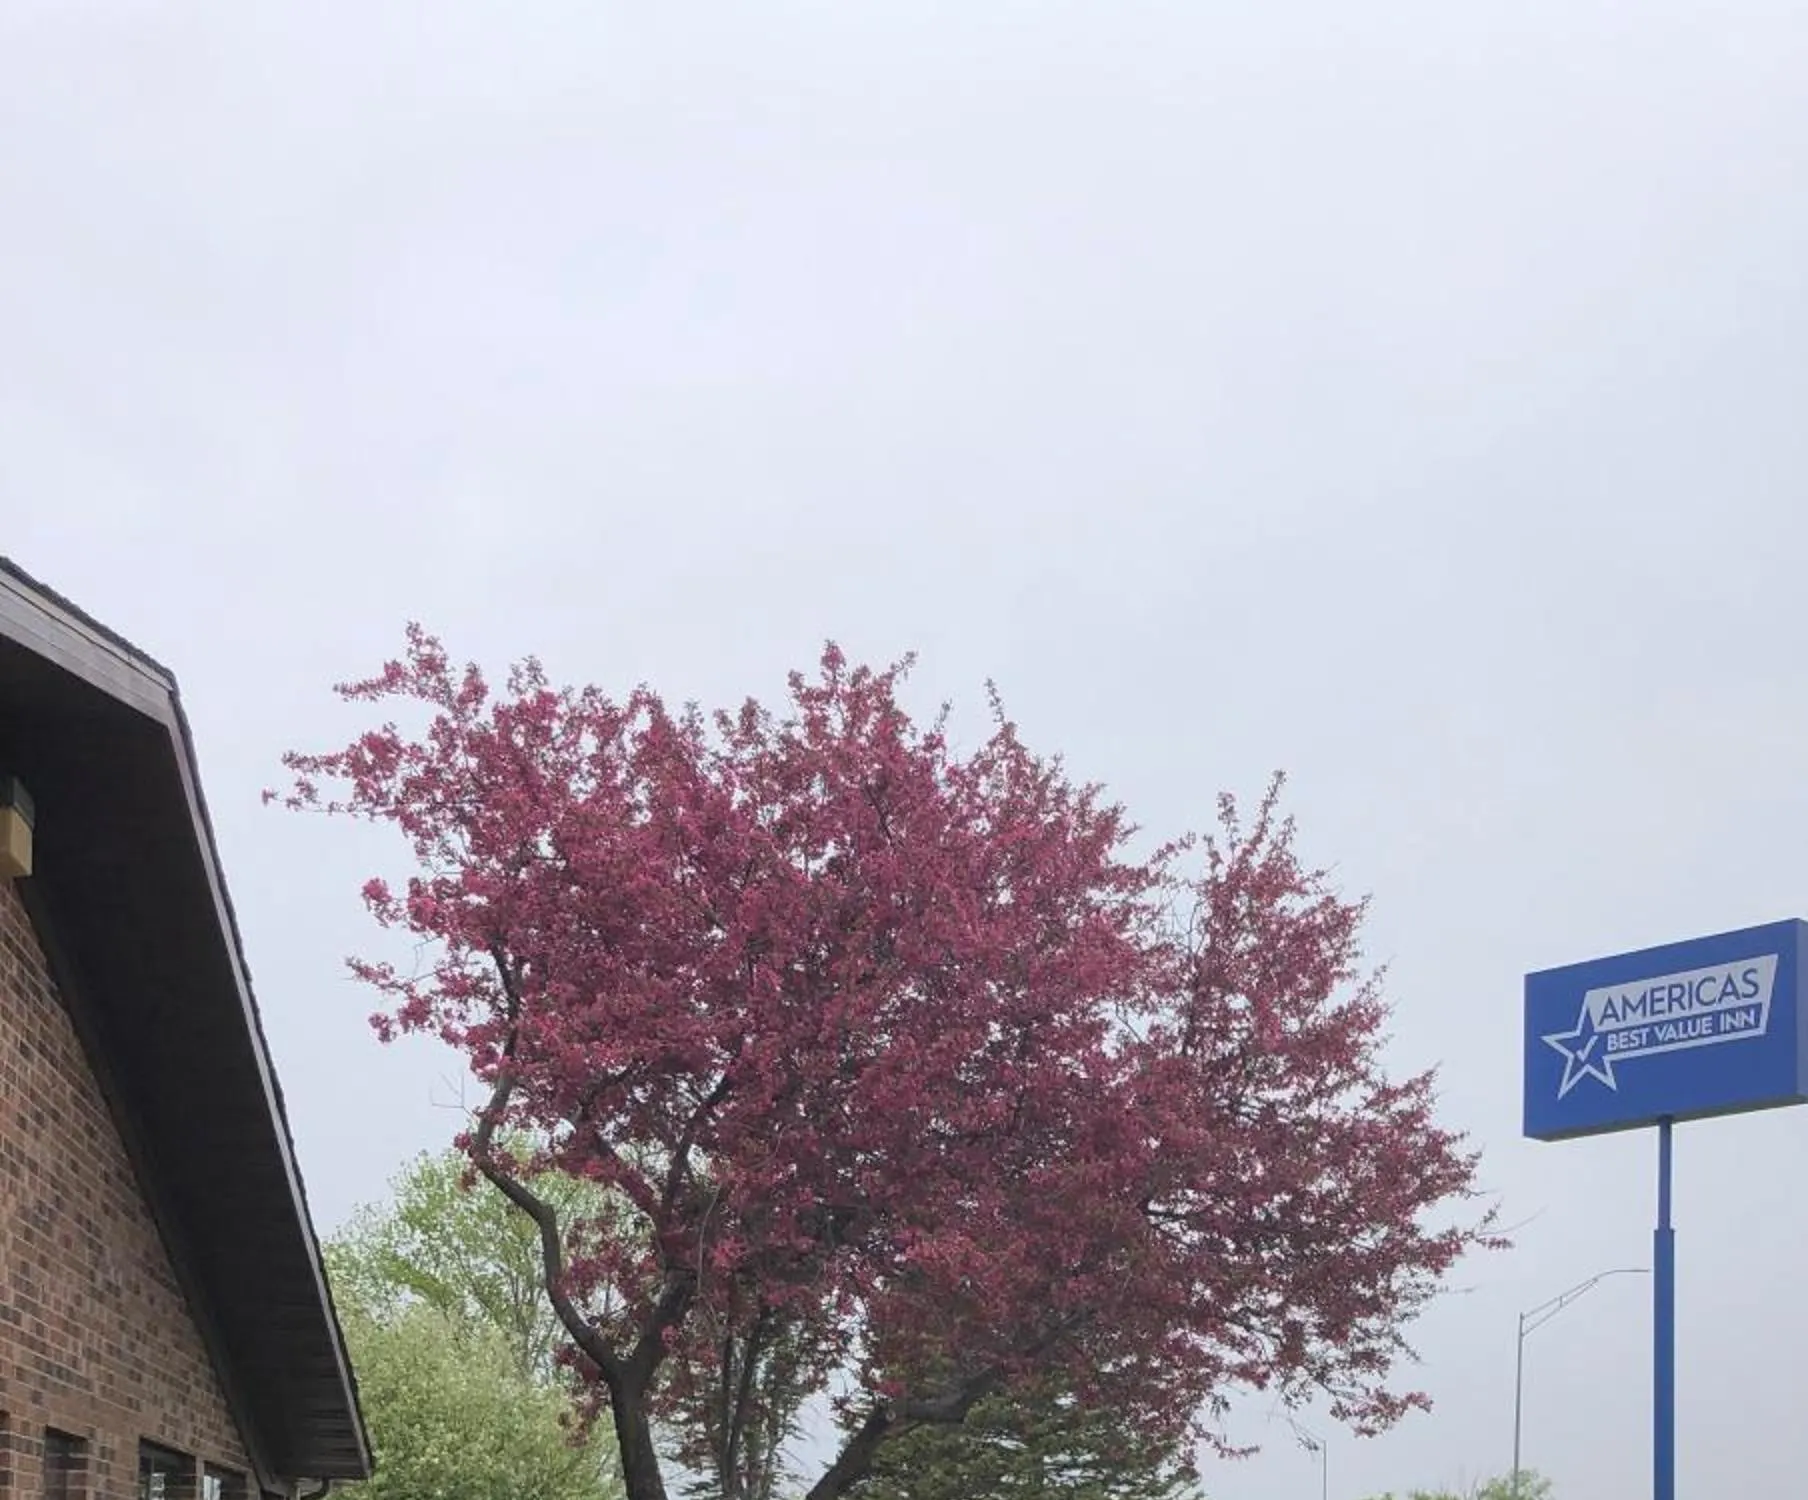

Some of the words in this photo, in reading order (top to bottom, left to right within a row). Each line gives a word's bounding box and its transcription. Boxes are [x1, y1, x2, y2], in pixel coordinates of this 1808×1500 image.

[1598, 968, 1760, 1027] AMERICAS
[1607, 1027, 1650, 1051] BEST
[1653, 1015, 1712, 1041] VALUE
[1719, 1009, 1756, 1032] INN
